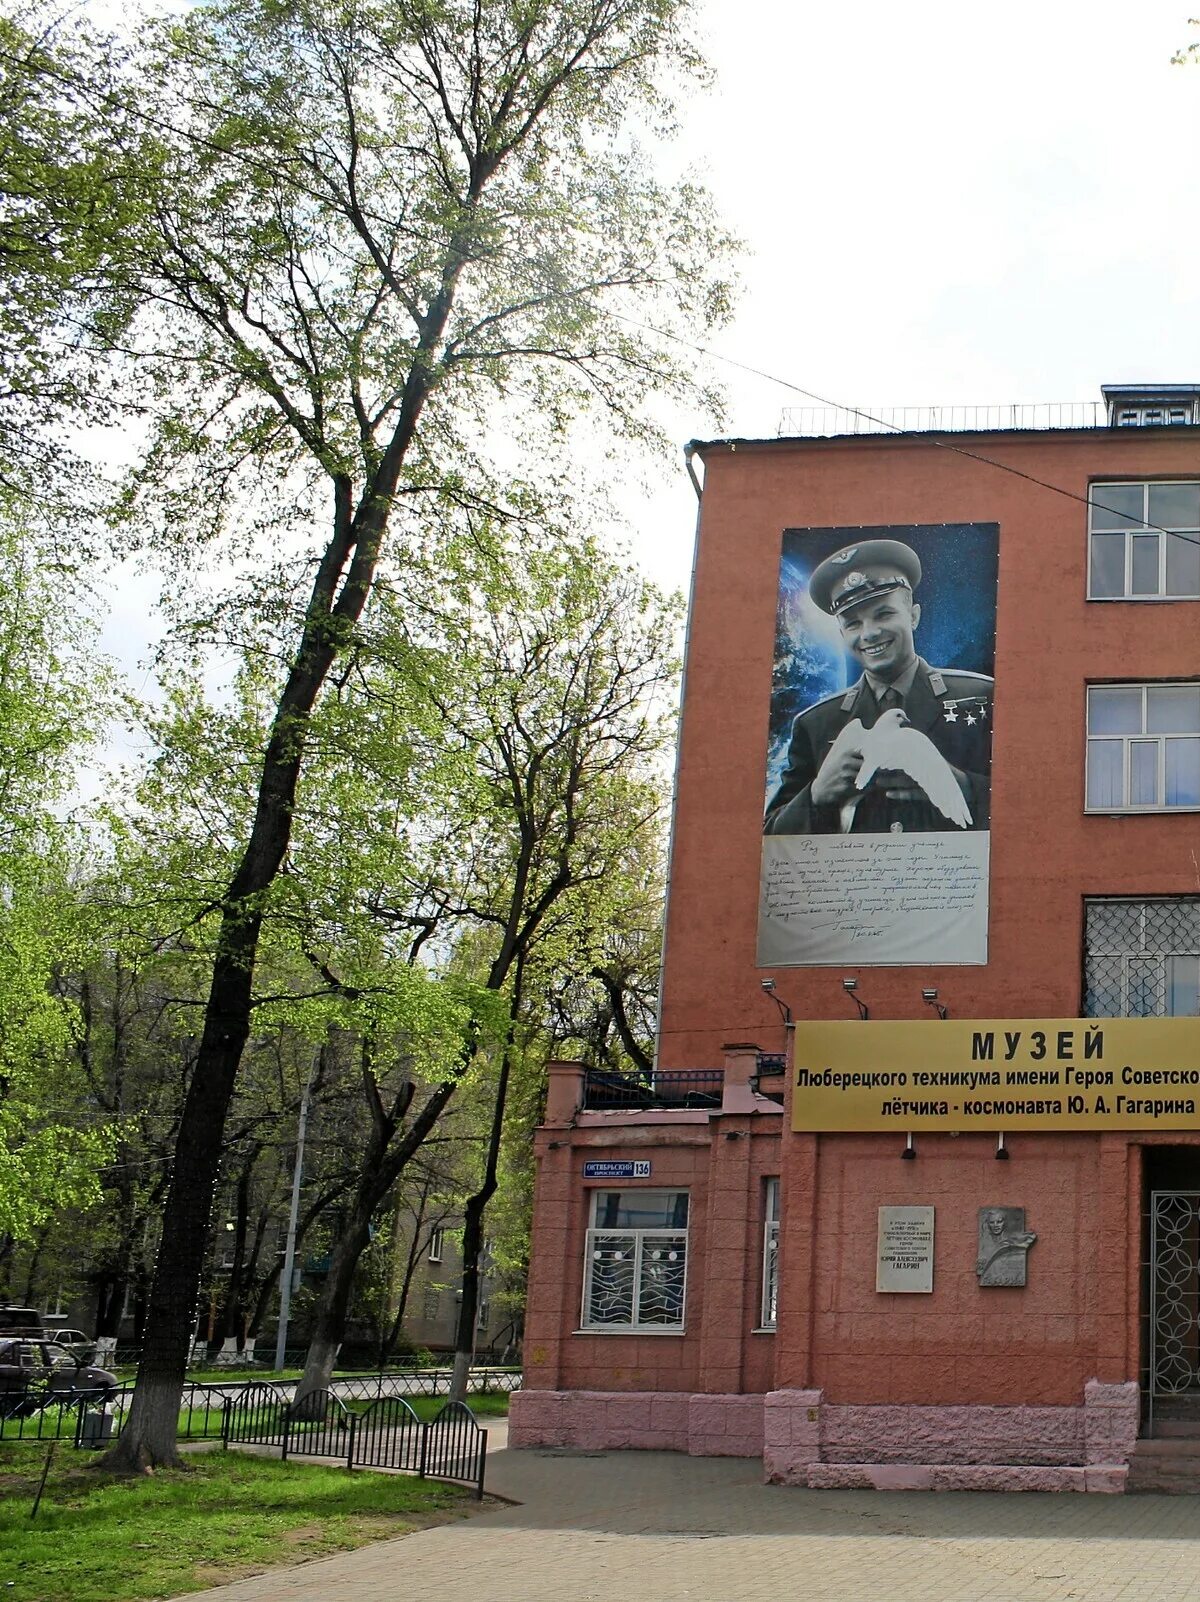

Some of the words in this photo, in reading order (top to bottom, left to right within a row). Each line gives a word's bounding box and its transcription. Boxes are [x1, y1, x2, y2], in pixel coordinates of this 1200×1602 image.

[972, 1025, 1103, 1060] МУЗЕЙ
[797, 1068, 907, 1090] Люберецкого
[912, 1071, 1000, 1090] техникума
[1006, 1070, 1059, 1085] имени
[1065, 1067, 1113, 1089] Героя
[881, 1097, 948, 1116] лётчика
[963, 1099, 1061, 1115] космонавта
[1067, 1096, 1089, 1114] Ю.
[1094, 1096, 1111, 1114] А.
[1116, 1096, 1195, 1118] Гагарина
[587, 1163, 632, 1171] ОКТЯБРЬСКИЙ
[636, 1163, 649, 1174] 136
